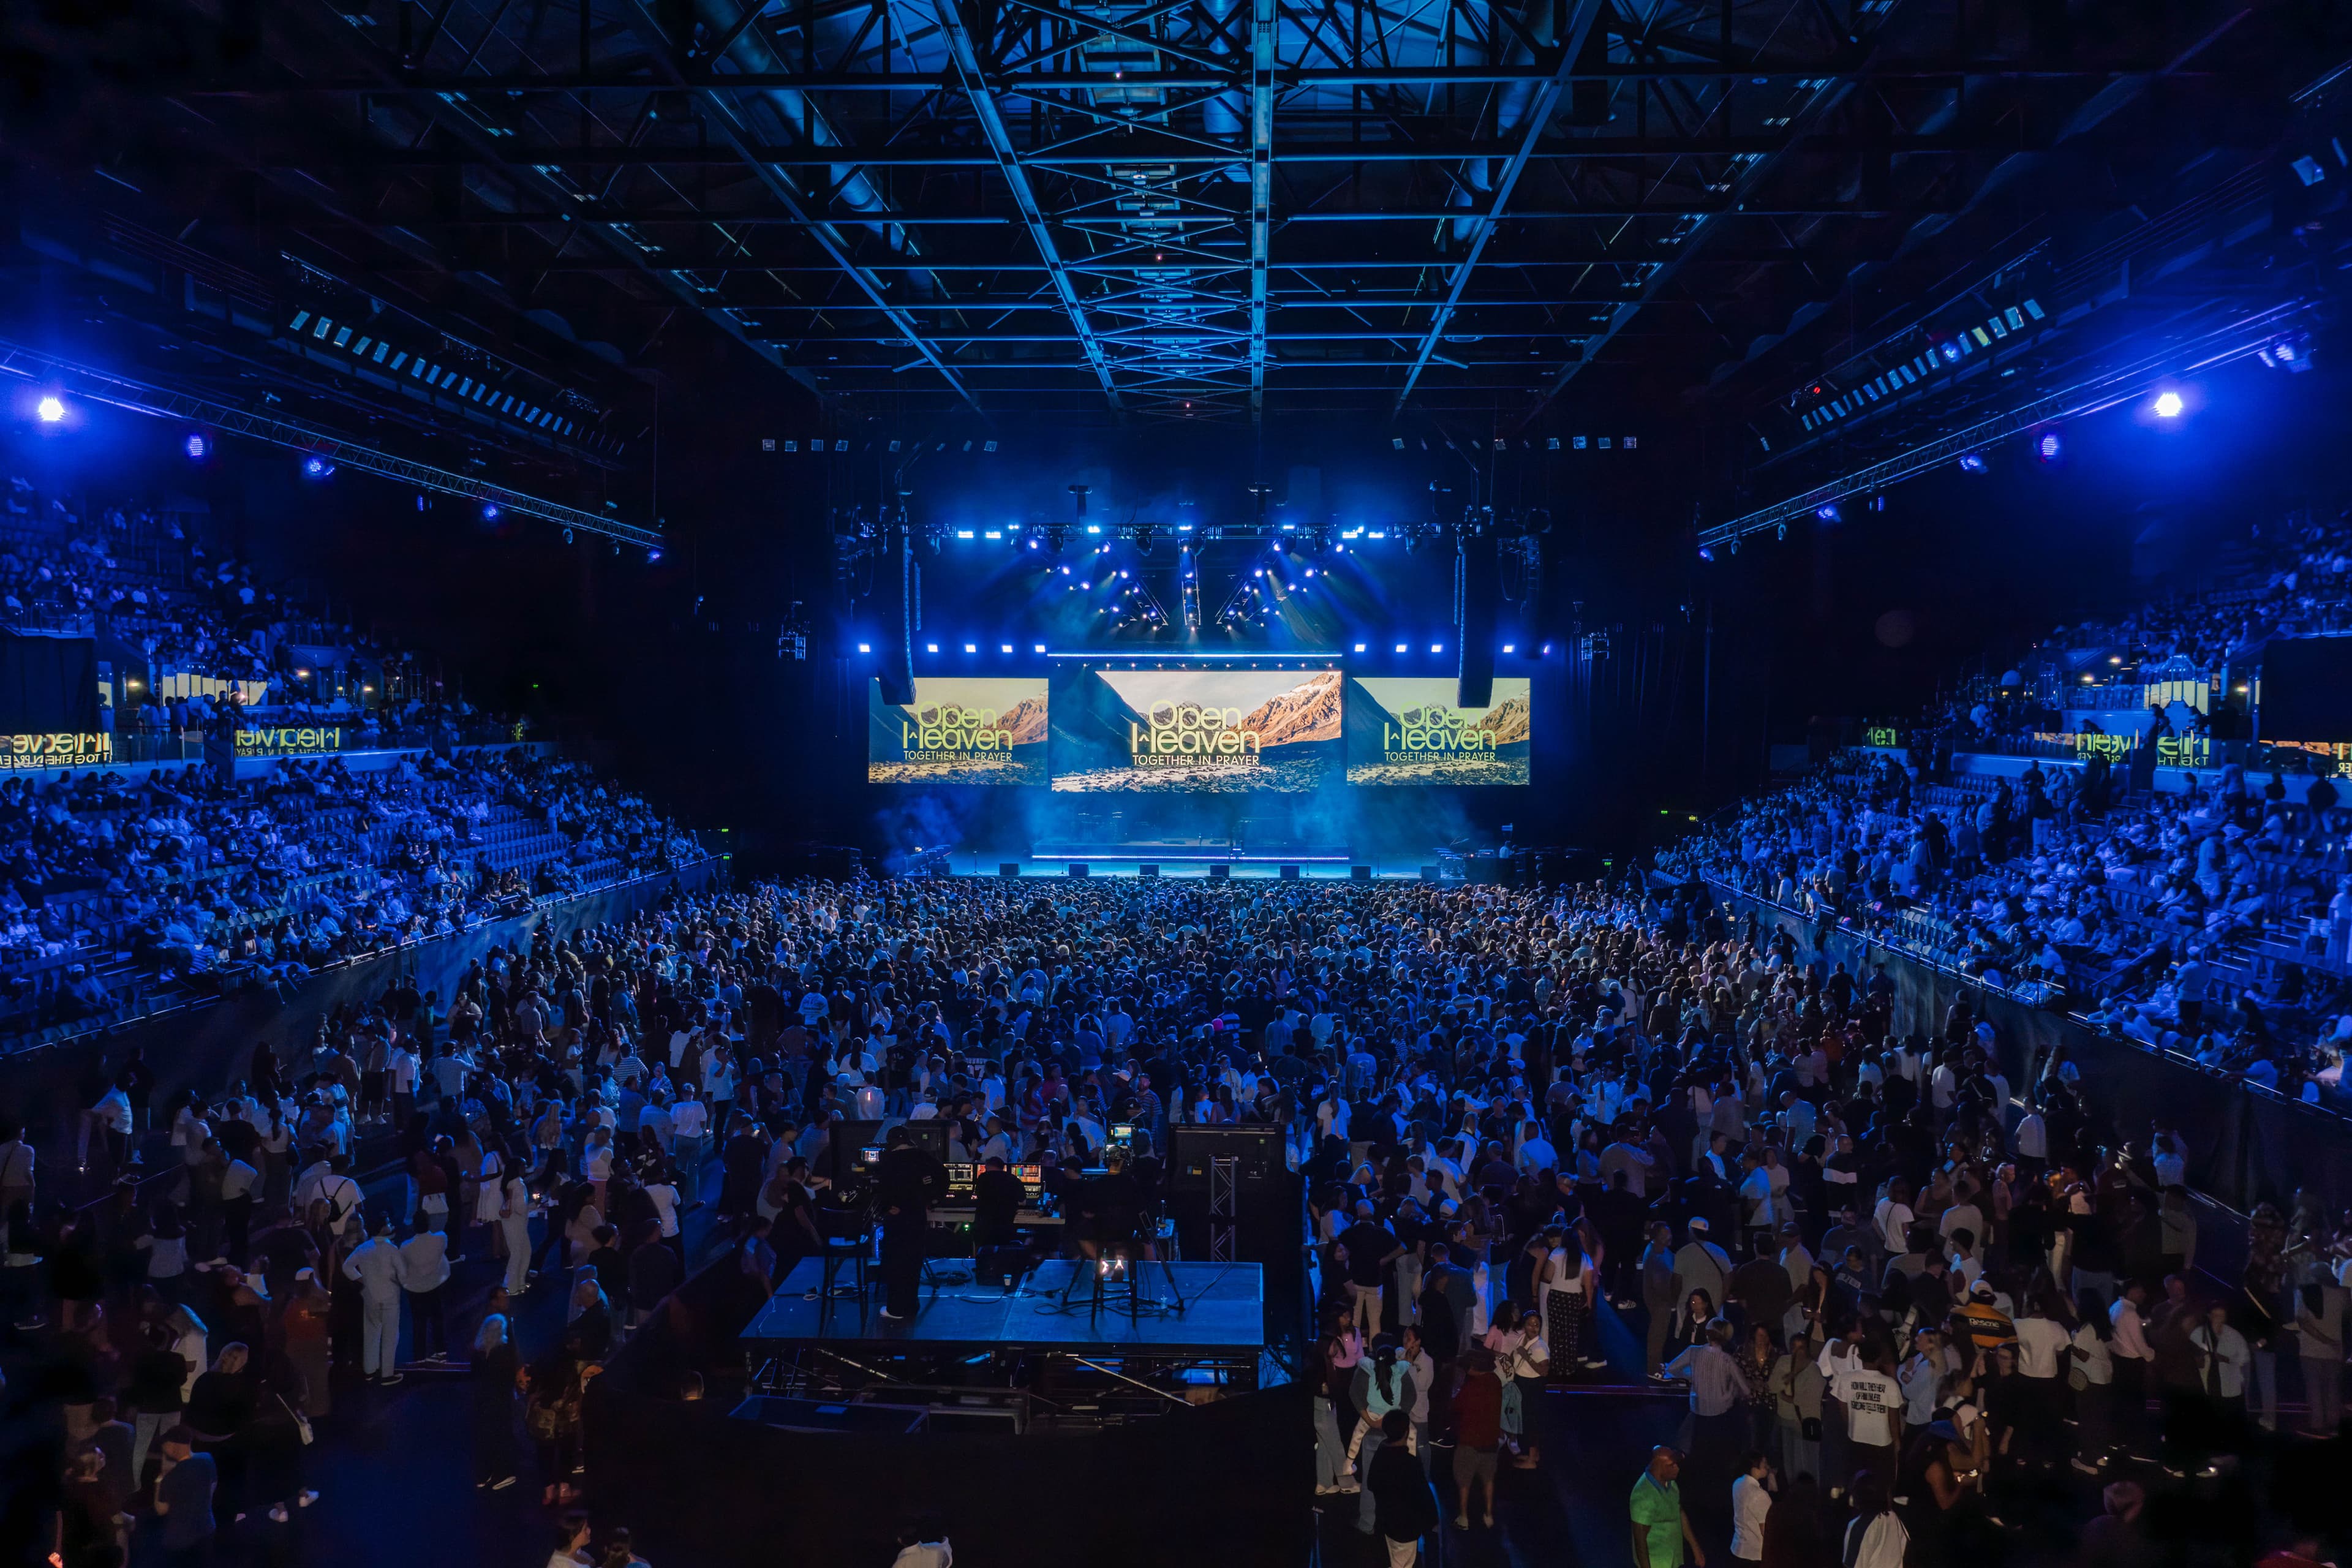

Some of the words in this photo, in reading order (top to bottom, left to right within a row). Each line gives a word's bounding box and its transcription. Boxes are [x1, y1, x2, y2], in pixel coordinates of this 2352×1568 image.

[917, 701, 997, 731] Open
[1148, 699, 1242, 734] Open
[1400, 701, 1481, 732] Open
[903, 722, 1013, 750] Heaven
[1132, 723, 1260, 753] Heaven
[1384, 722, 1496, 750] Heaven
[903, 750, 956, 761] TOGETHER
[959, 752, 970, 761] IN
[974, 752, 1012, 761] PRAYER
[1133, 755, 1194, 766] TOGETHER
[1199, 755, 1211, 766] IN
[1216, 755, 1259, 766] PRAYER
[1384, 752, 1439, 761] TOGETHER
[1444, 752, 1455, 761] IN
[1459, 752, 1495, 761] PRAYER
